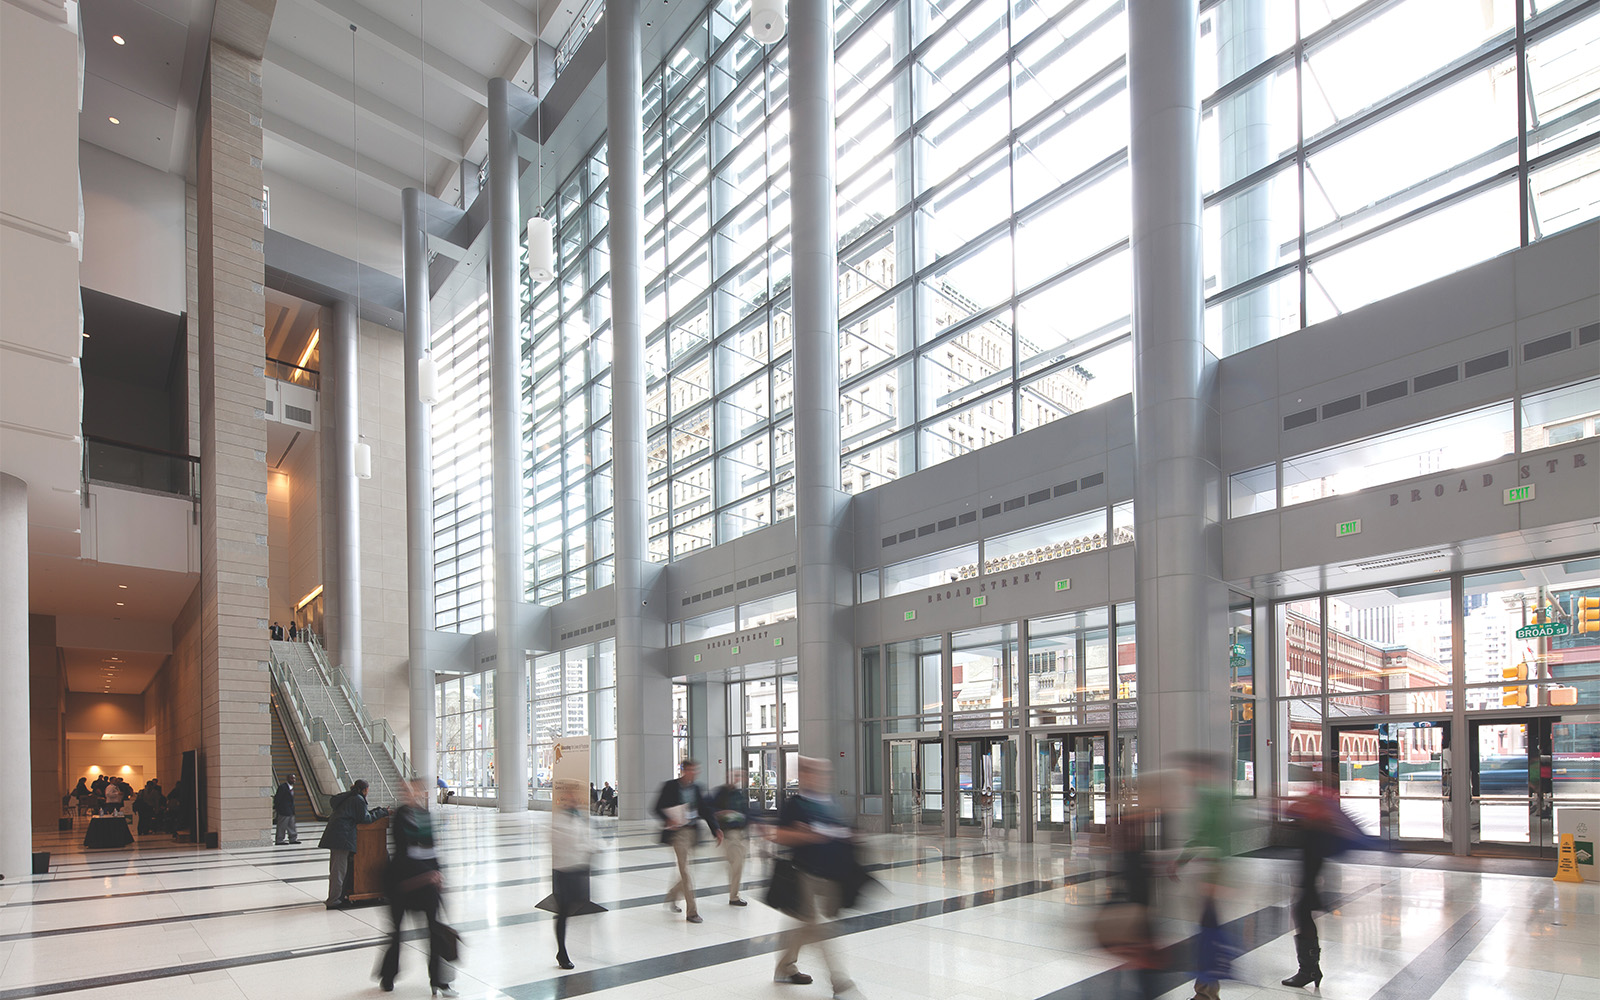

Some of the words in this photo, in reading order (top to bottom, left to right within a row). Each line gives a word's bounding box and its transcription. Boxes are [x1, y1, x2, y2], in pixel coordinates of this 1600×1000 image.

[1390, 473, 1493, 506] BROAD
[1520, 453, 1587, 479] STR
[1509, 486, 1530, 501] EXIT
[1340, 521, 1357, 535] EXIT
[928, 587, 971, 603] BROAD
[980, 571, 1041, 592] STREET
[1057, 580, 1067, 590] EXIT
[1518, 628, 1553, 638] BROAD
